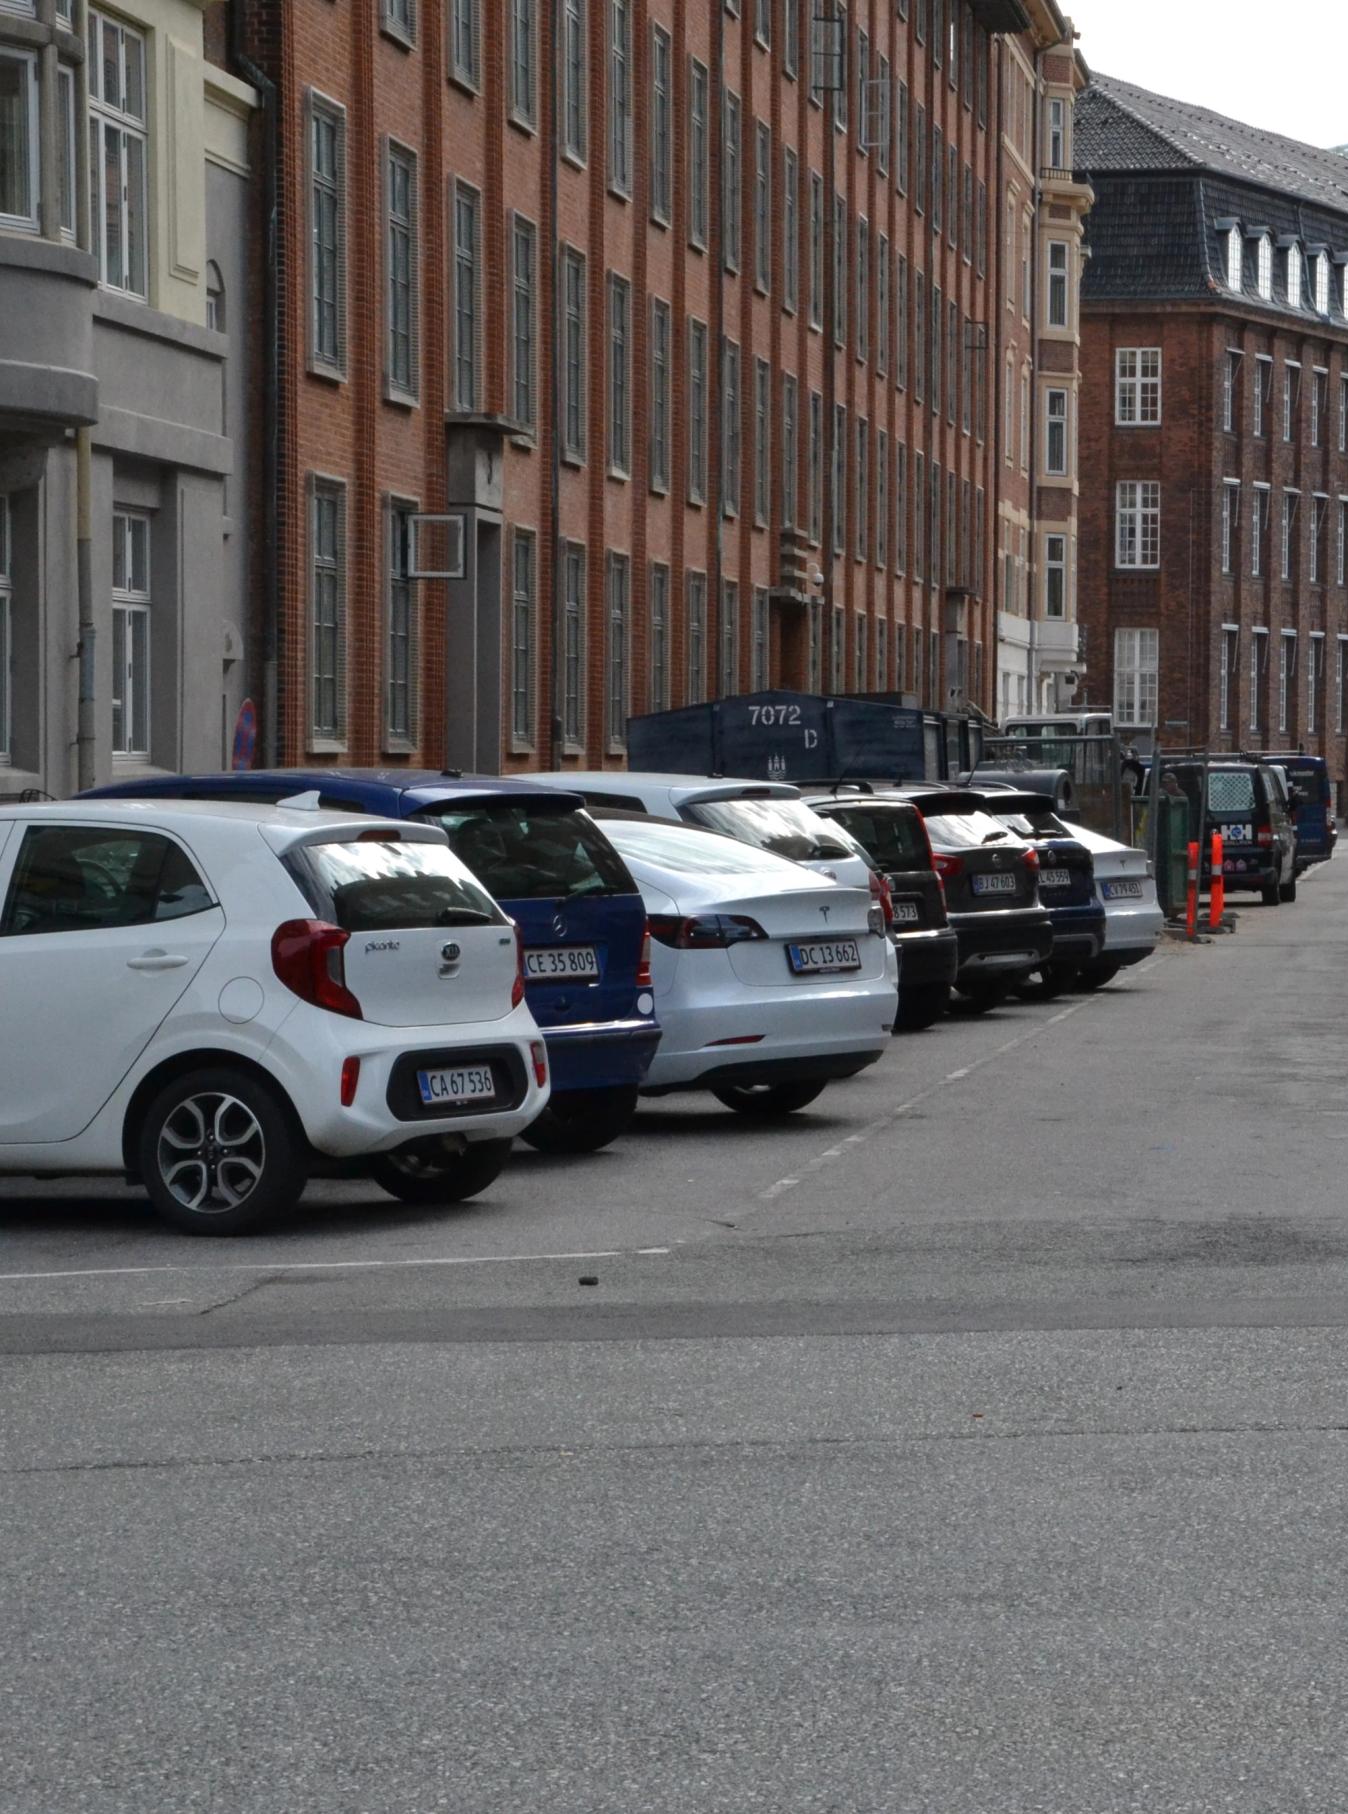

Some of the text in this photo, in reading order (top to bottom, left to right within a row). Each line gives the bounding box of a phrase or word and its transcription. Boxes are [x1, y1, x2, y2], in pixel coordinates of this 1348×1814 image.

[748, 705, 802, 726] 7072
[804, 729, 818, 749] D
[901, 903, 917, 919] 573
[527, 951, 594, 973] CE 35 809
[800, 944, 857, 965] DC 13 662
[430, 1069, 492, 1097] CA 67 536
